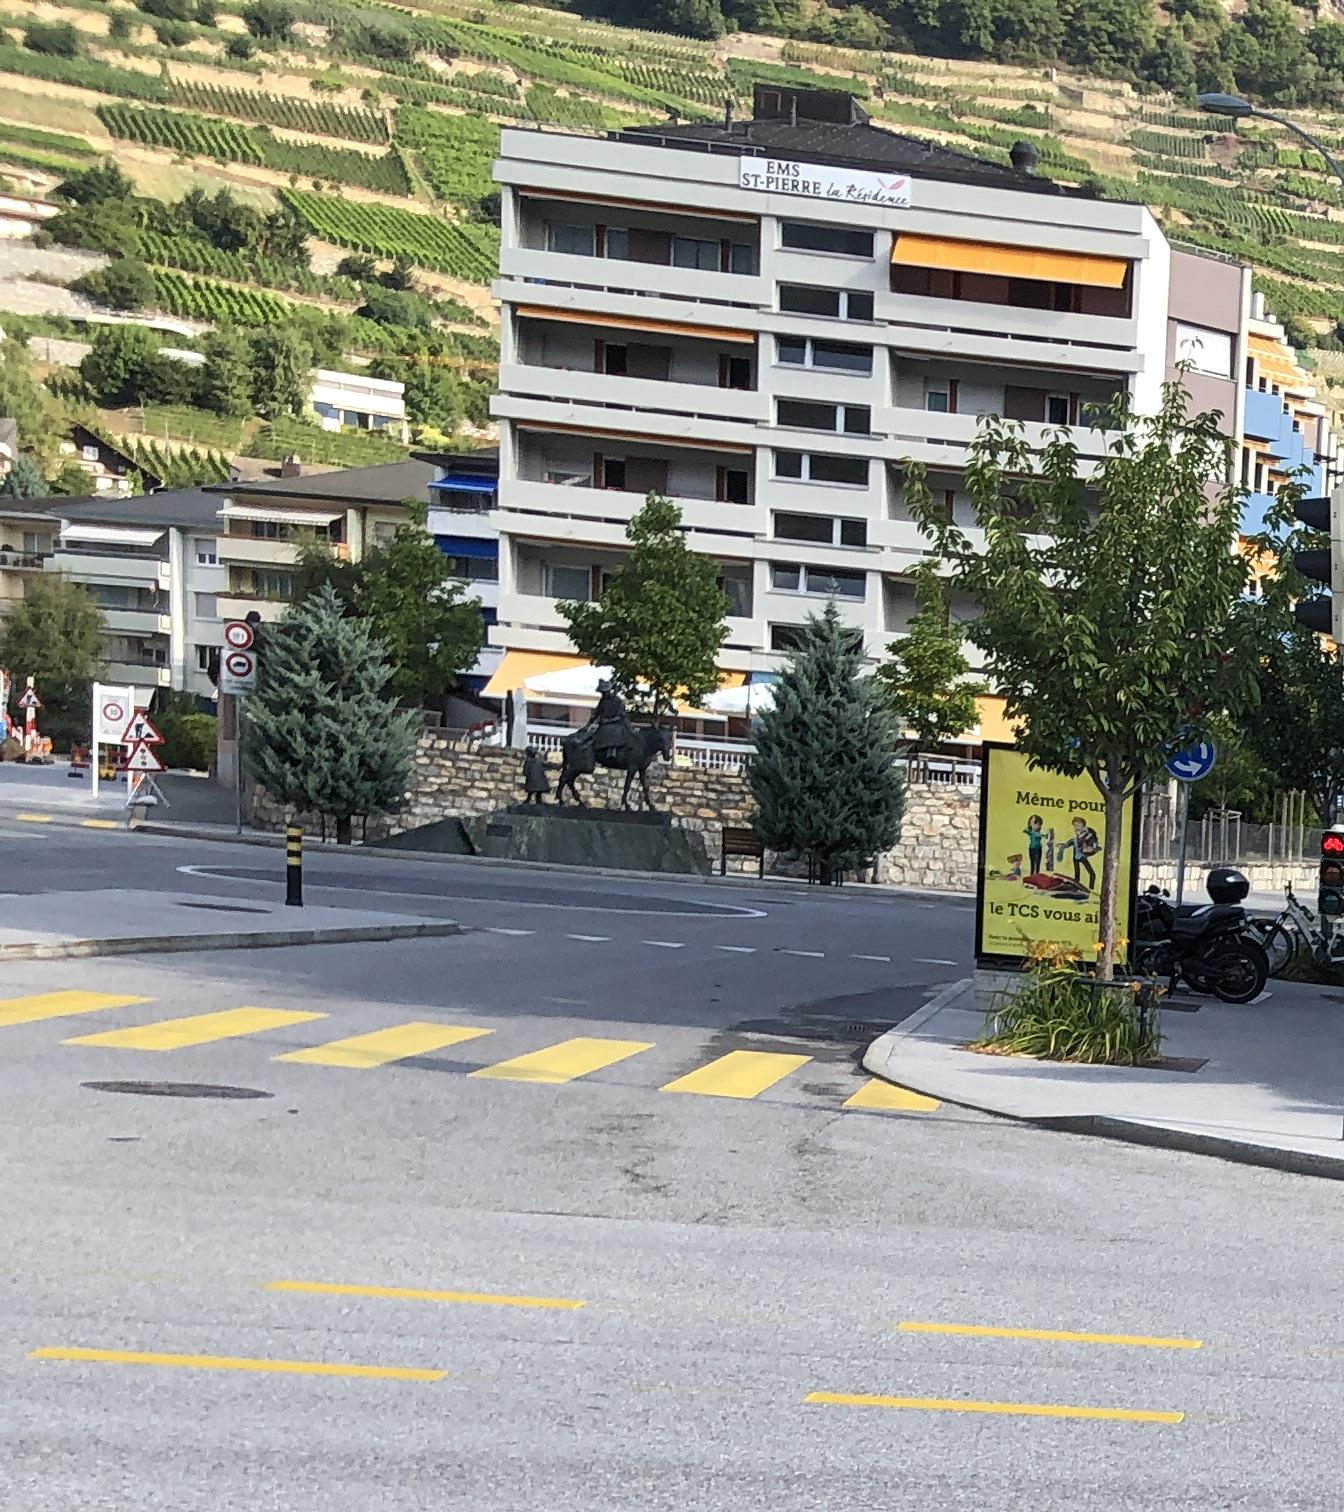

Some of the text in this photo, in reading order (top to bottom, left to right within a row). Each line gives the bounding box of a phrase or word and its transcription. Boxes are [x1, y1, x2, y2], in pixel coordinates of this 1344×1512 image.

[766, 160, 800, 178] EMS
[742, 172, 822, 196] ST-PIERRE
[1015, 790, 1105, 813] Même pour
[989, 901, 1004, 915] le
[1008, 903, 1040, 919] TCS
[1043, 909, 1082, 922] vous
